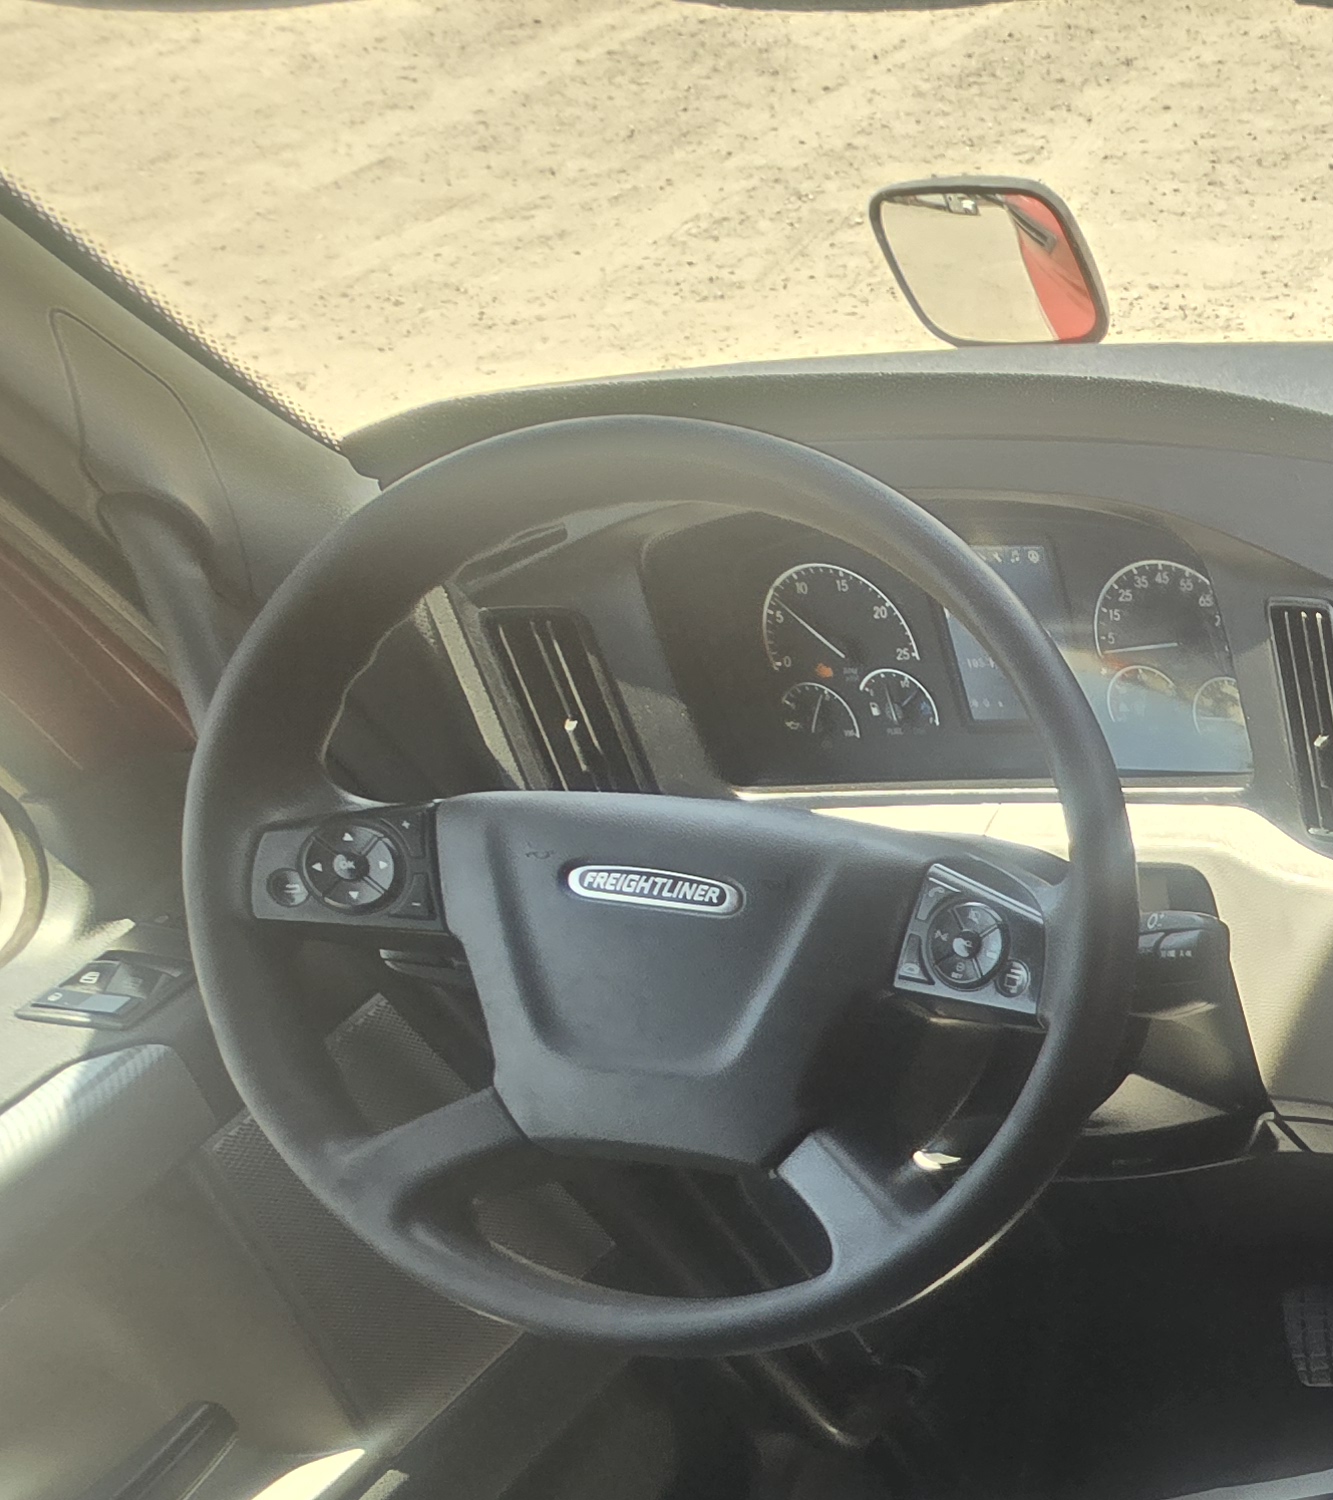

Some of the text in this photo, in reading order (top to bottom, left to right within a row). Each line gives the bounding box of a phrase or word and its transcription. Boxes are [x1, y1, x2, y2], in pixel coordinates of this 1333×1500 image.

[1133, 575, 1149, 589] 35
[1154, 571, 1170, 584] 45
[795, 582, 808, 595] 10
[835, 579, 849, 592] 15
[1179, 577, 1194, 592] 55
[1118, 589, 1133, 602] 25
[775, 612, 784, 624] 5
[873, 605, 888, 620] 20
[1108, 609, 1121, 622] 15
[1107, 632, 1116, 645] 5
[896, 652, 910, 661] 25
[583, 871, 721, 903] FREIGHTLINER
